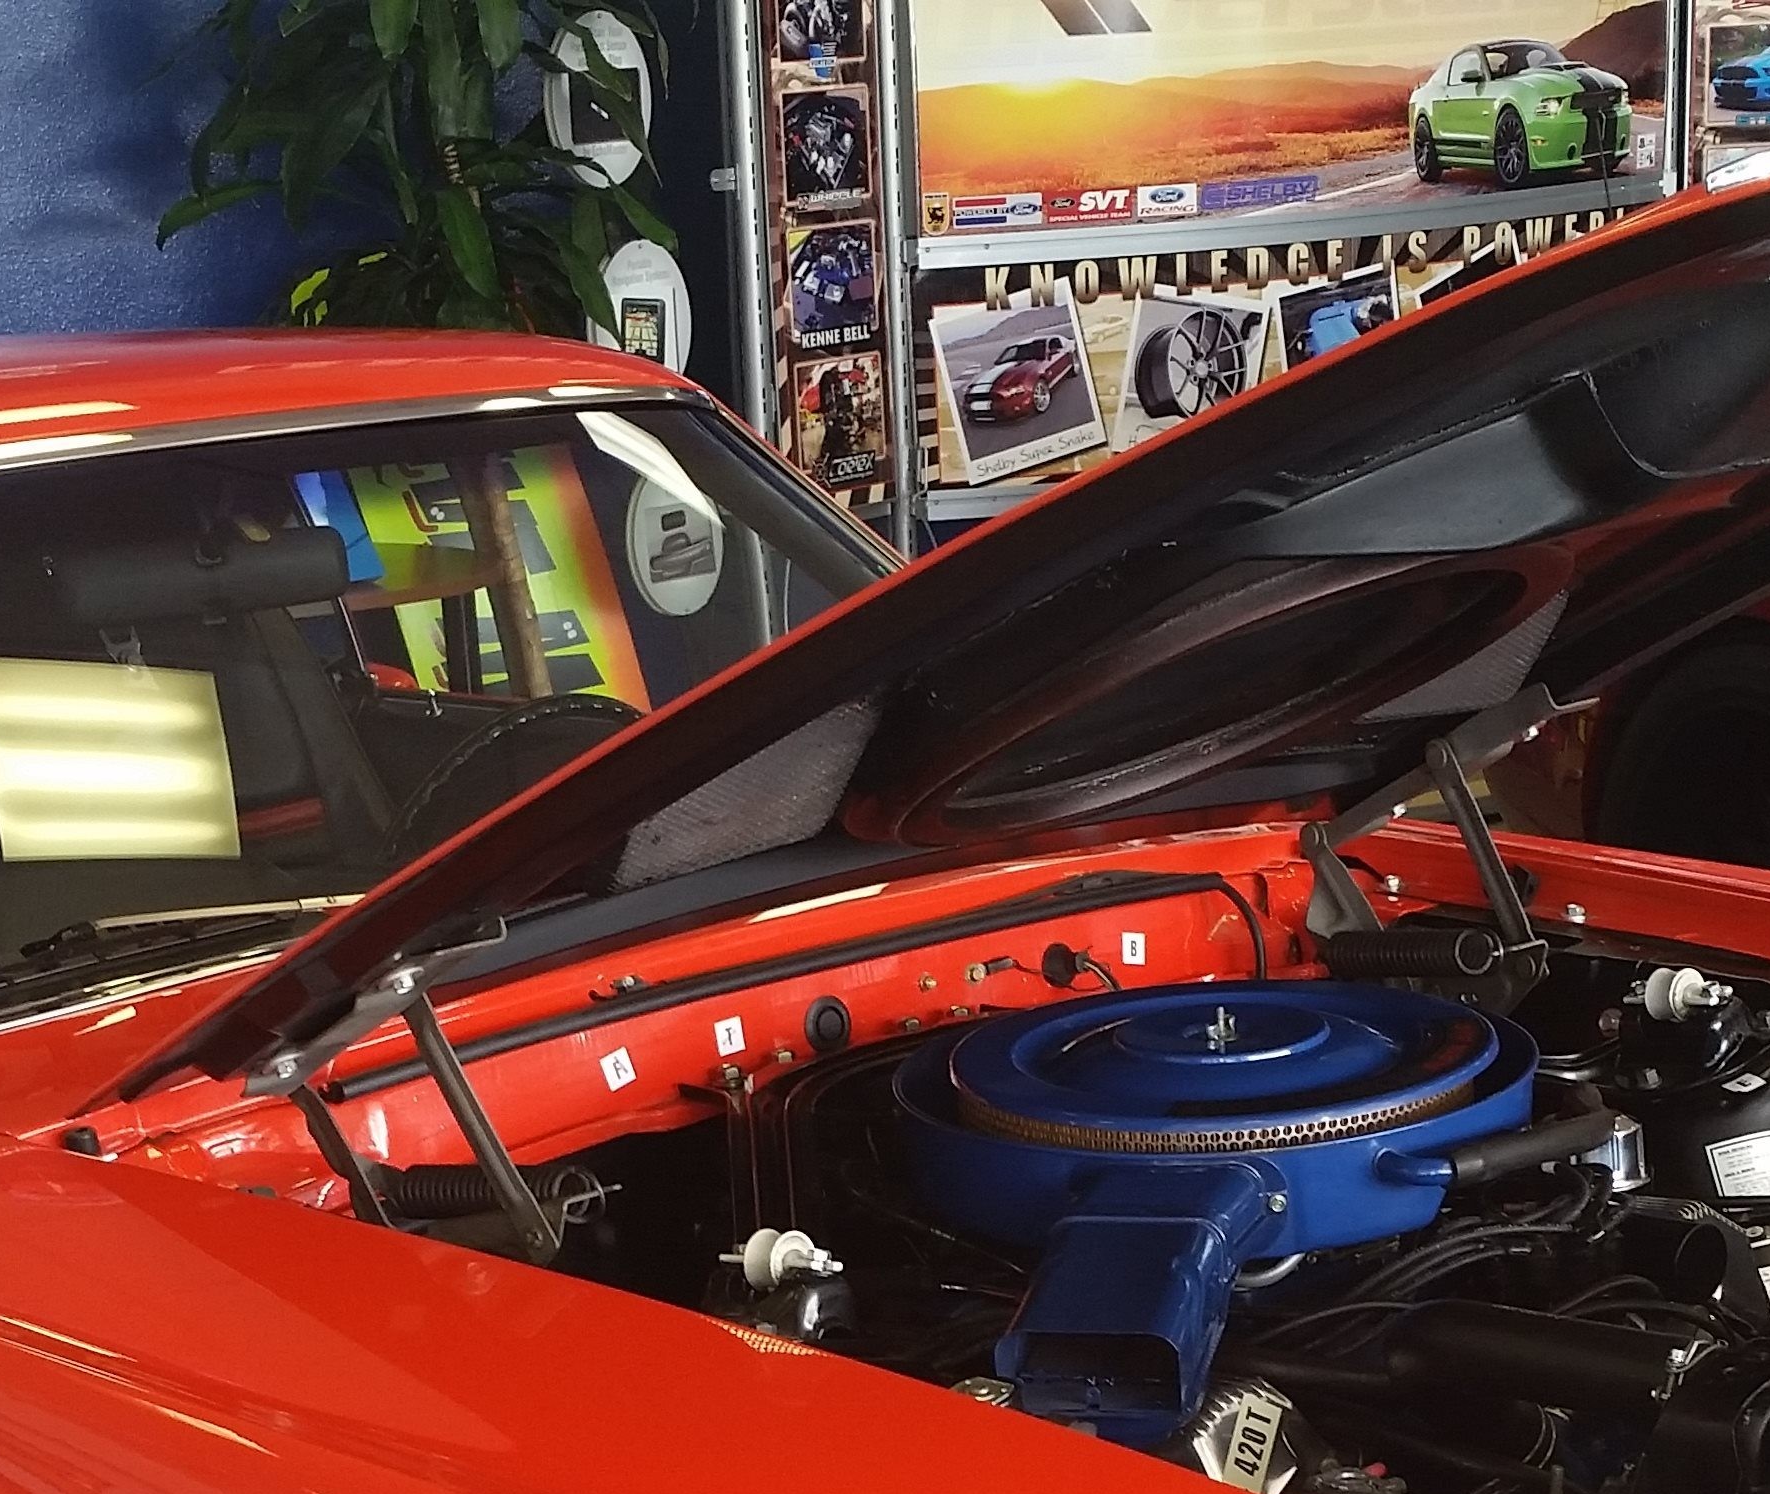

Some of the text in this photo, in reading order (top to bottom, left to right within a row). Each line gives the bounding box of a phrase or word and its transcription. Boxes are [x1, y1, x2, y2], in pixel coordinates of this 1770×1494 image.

[810, 189, 862, 203] WHIPPLE
[1079, 189, 1130, 213] SVT
[1155, 188, 1180, 202] Ford
[1227, 181, 1314, 202] SHELBY
[954, 203, 1038, 217] POWERED BY Ford
[1049, 211, 1131, 224] SPECIAL VEHICLE TEAM
[1140, 204, 1195, 216] RACING
[984, 239, 1343, 311] KNOWLEDGE
[1382, 231, 1427, 274] IS
[801, 325, 871, 349] KENNE BELL
[977, 455, 1015, 478] Shelby
[1058, 431, 1095, 450] Snake
[1130, 940, 1137, 957] B
[1234, 1406, 1271, 1477] 420 T
